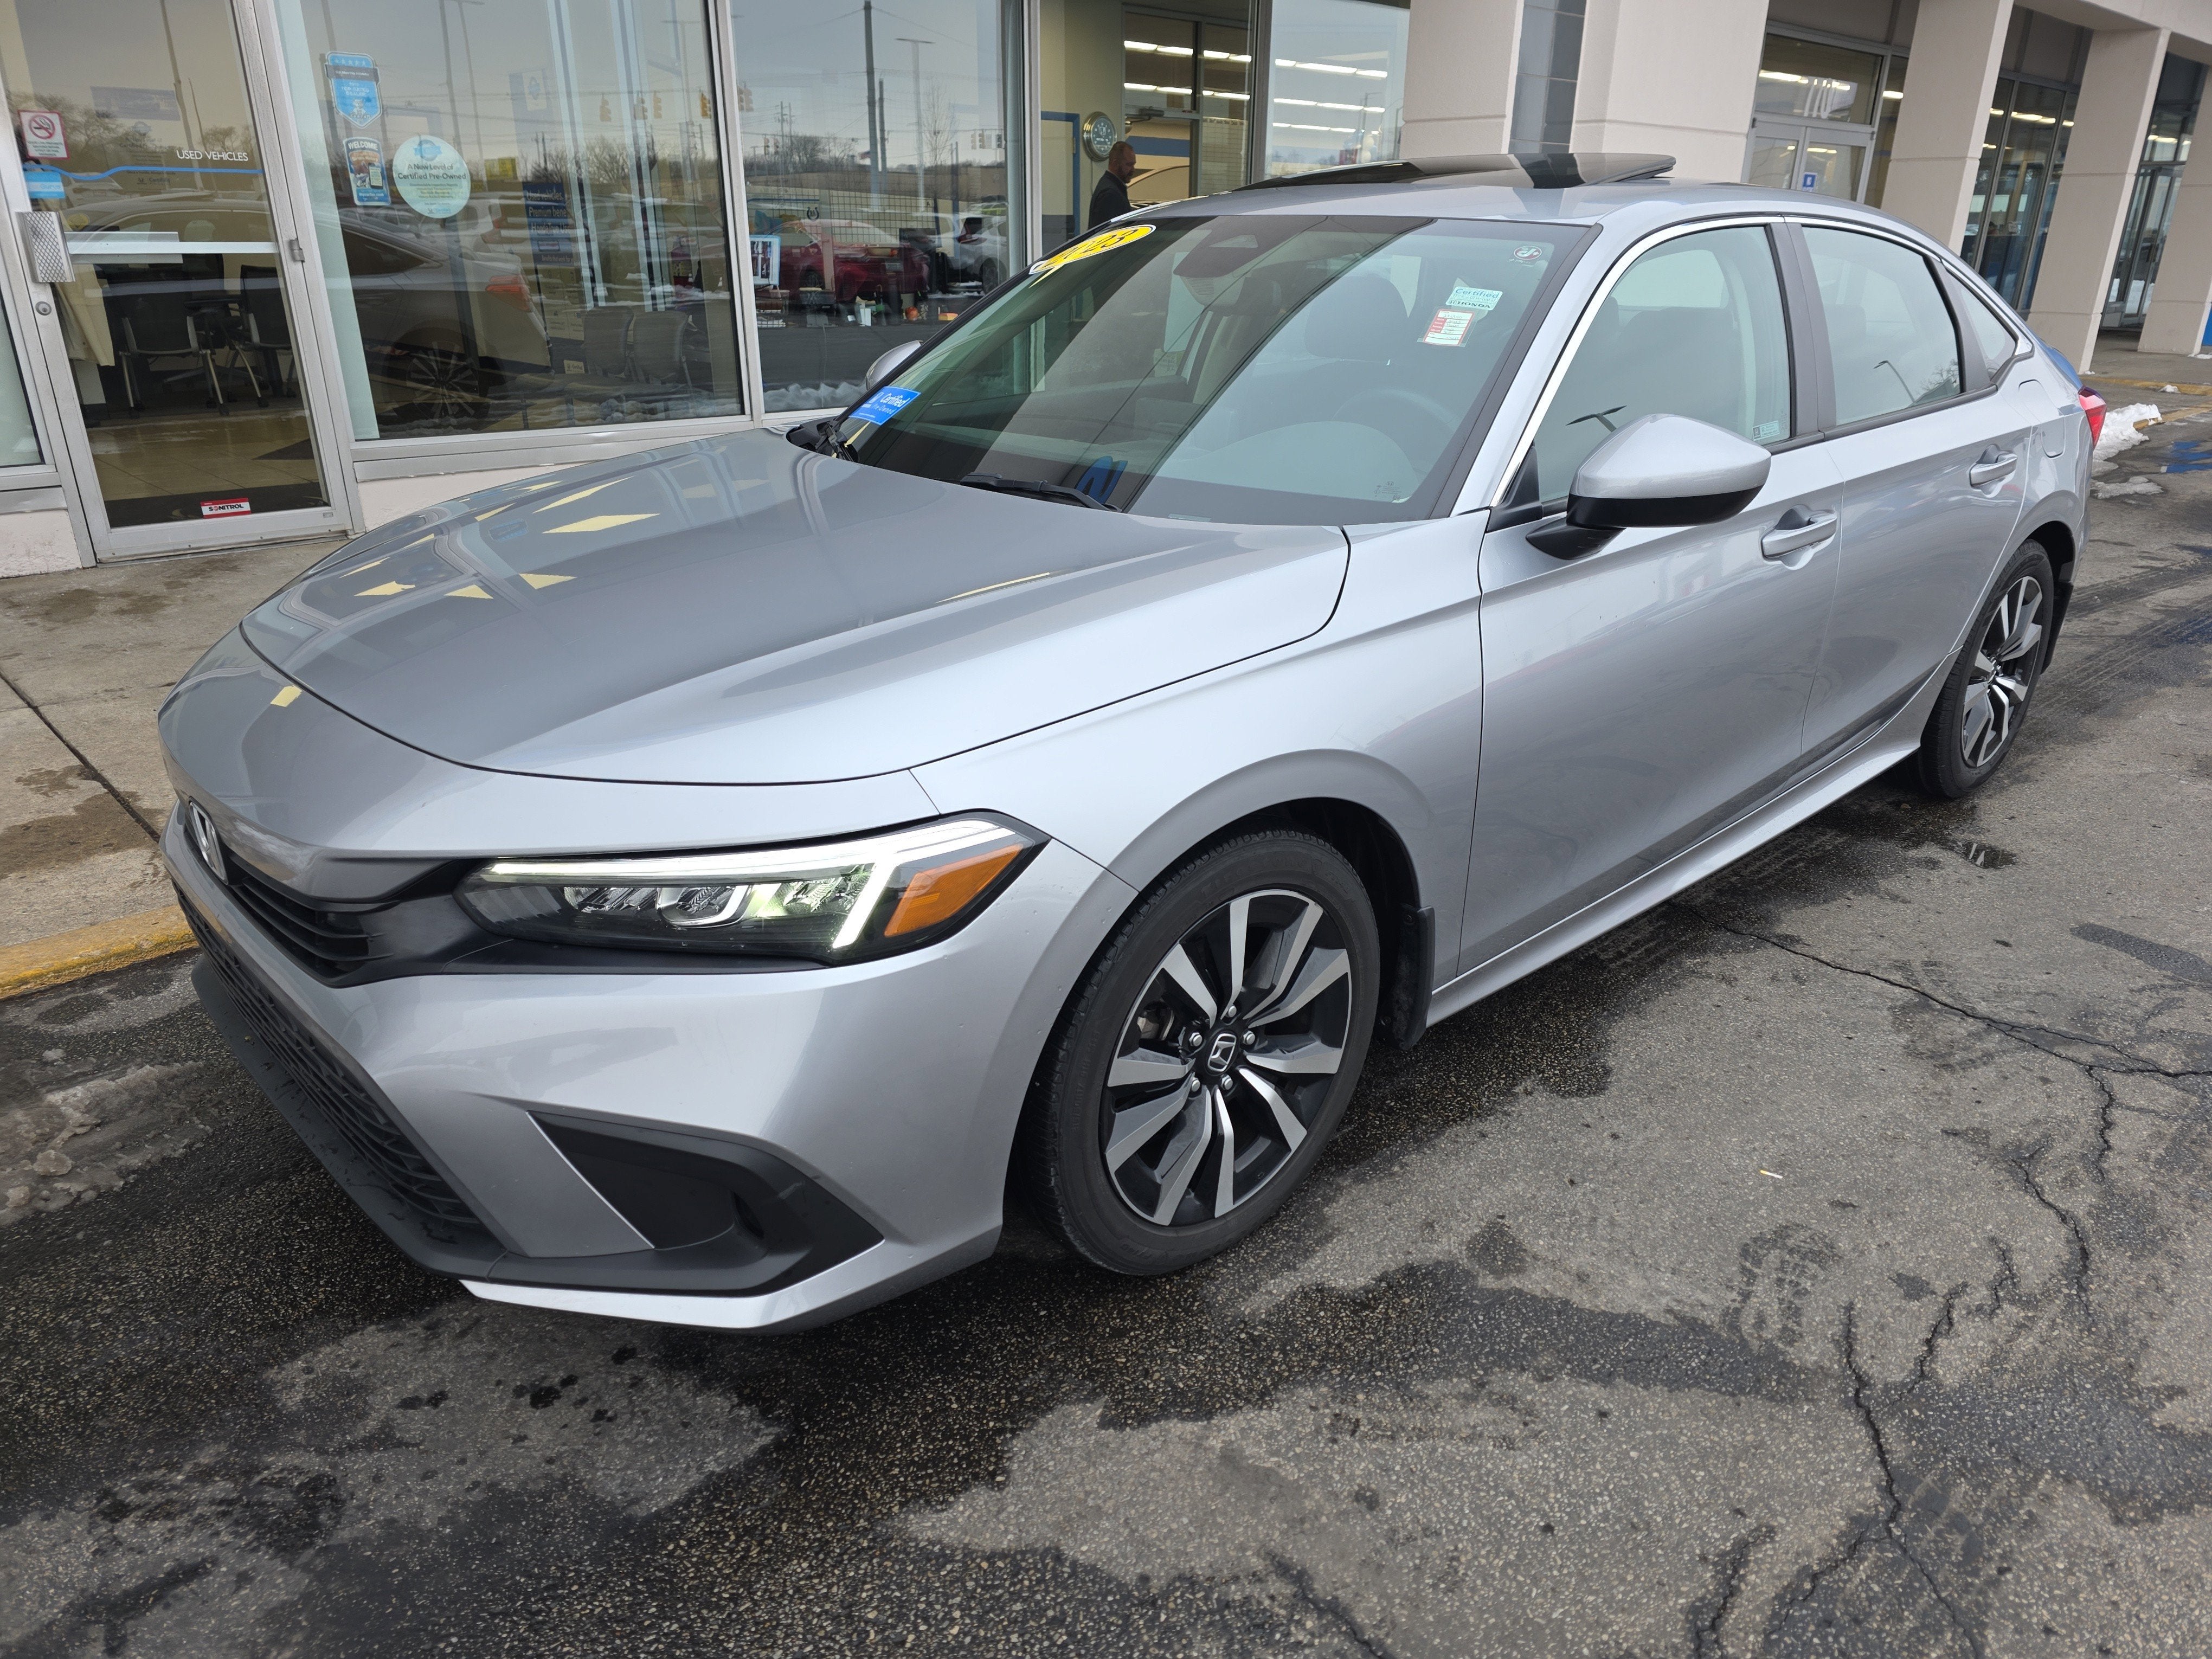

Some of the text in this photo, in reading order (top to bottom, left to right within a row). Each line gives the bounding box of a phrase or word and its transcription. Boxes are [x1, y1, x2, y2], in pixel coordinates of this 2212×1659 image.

[348, 141, 378, 151] WELCOME
[176, 150, 203, 159] USED
[205, 151, 249, 161] VEHICLES
[527, 189, 541, 201] Used
[528, 207, 552, 217] Premium
[1455, 288, 1500, 298] Certified
[880, 393, 911, 408] Certified
[872, 403, 897, 415] Pre-Owned
[208, 504, 244, 512] SONITROL
